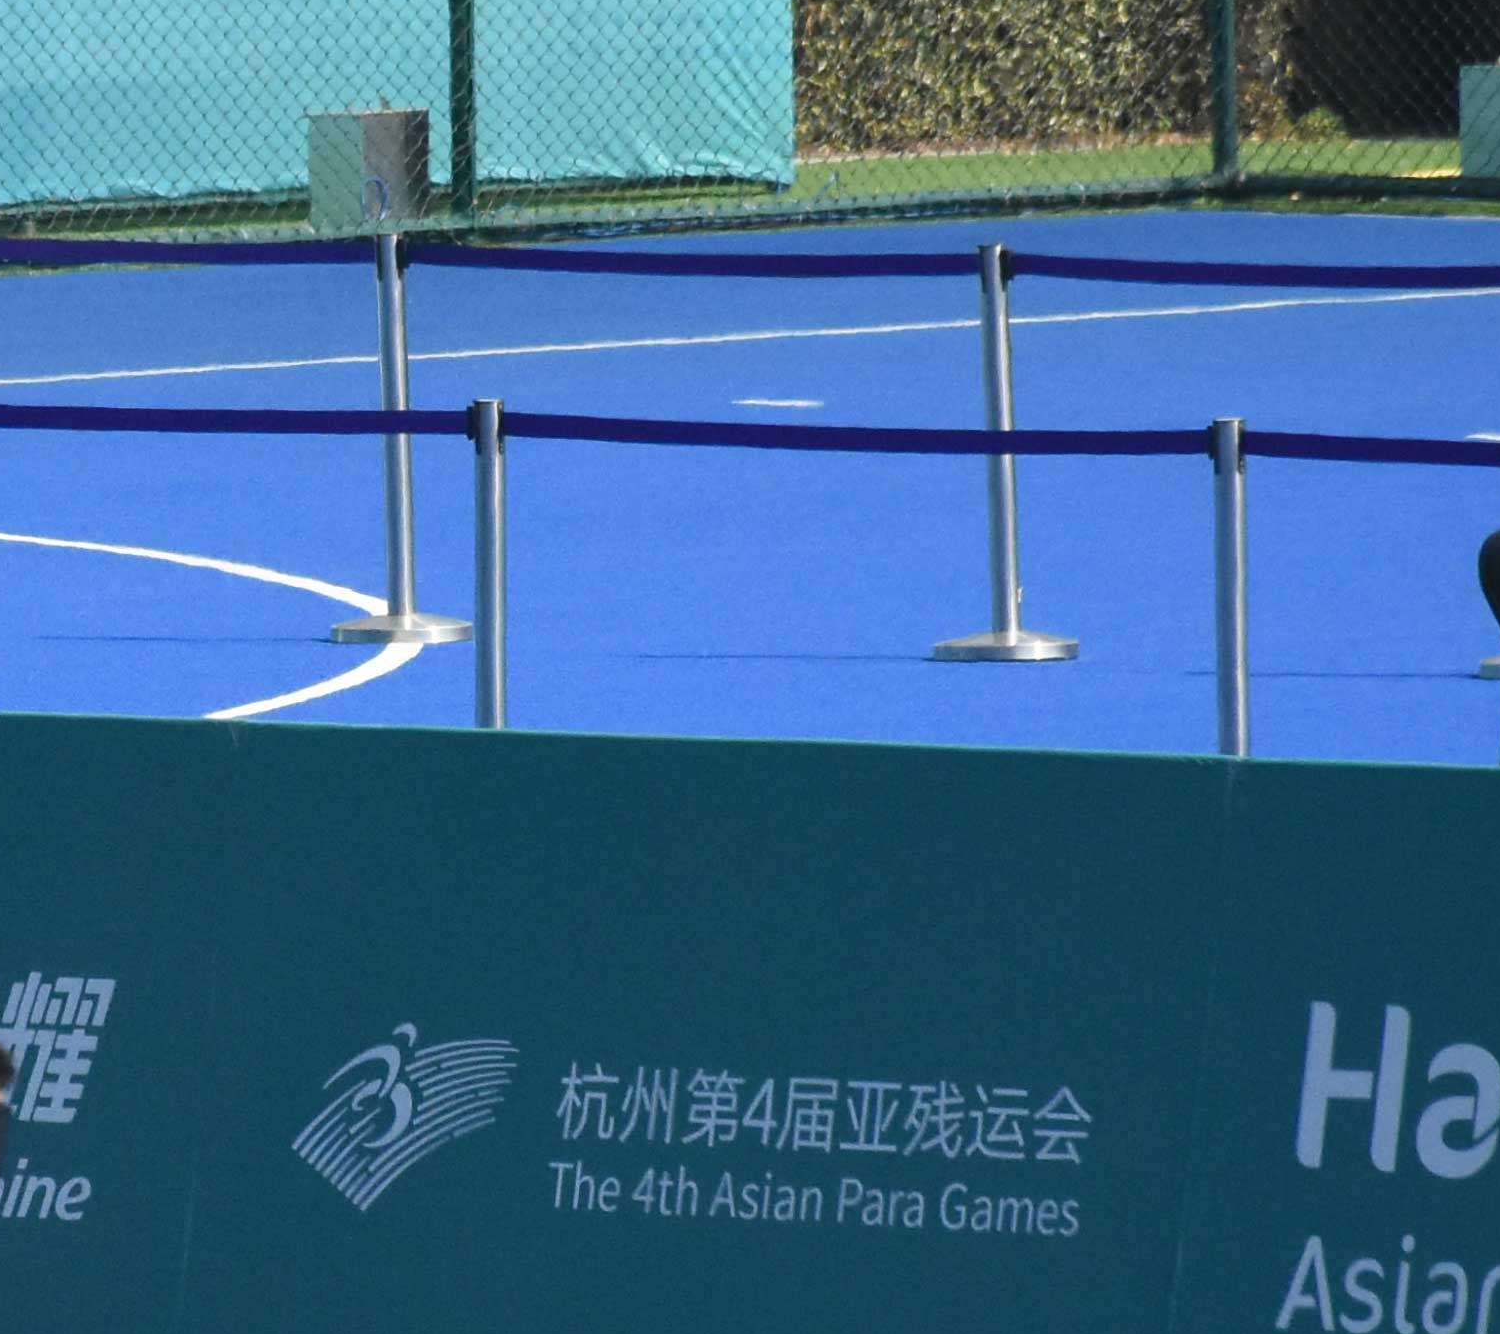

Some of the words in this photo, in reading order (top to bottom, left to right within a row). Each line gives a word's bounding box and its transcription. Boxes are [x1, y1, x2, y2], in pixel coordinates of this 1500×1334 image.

[555, 1061, 1093, 1165] 杭州第4届亚残运会
[548, 1160, 621, 1213] The
[631, 1164, 699, 1216] 4th
[708, 1170, 823, 1223] Asian
[836, 1176, 926, 1229] Para
[939, 1180, 1081, 1238] Games
